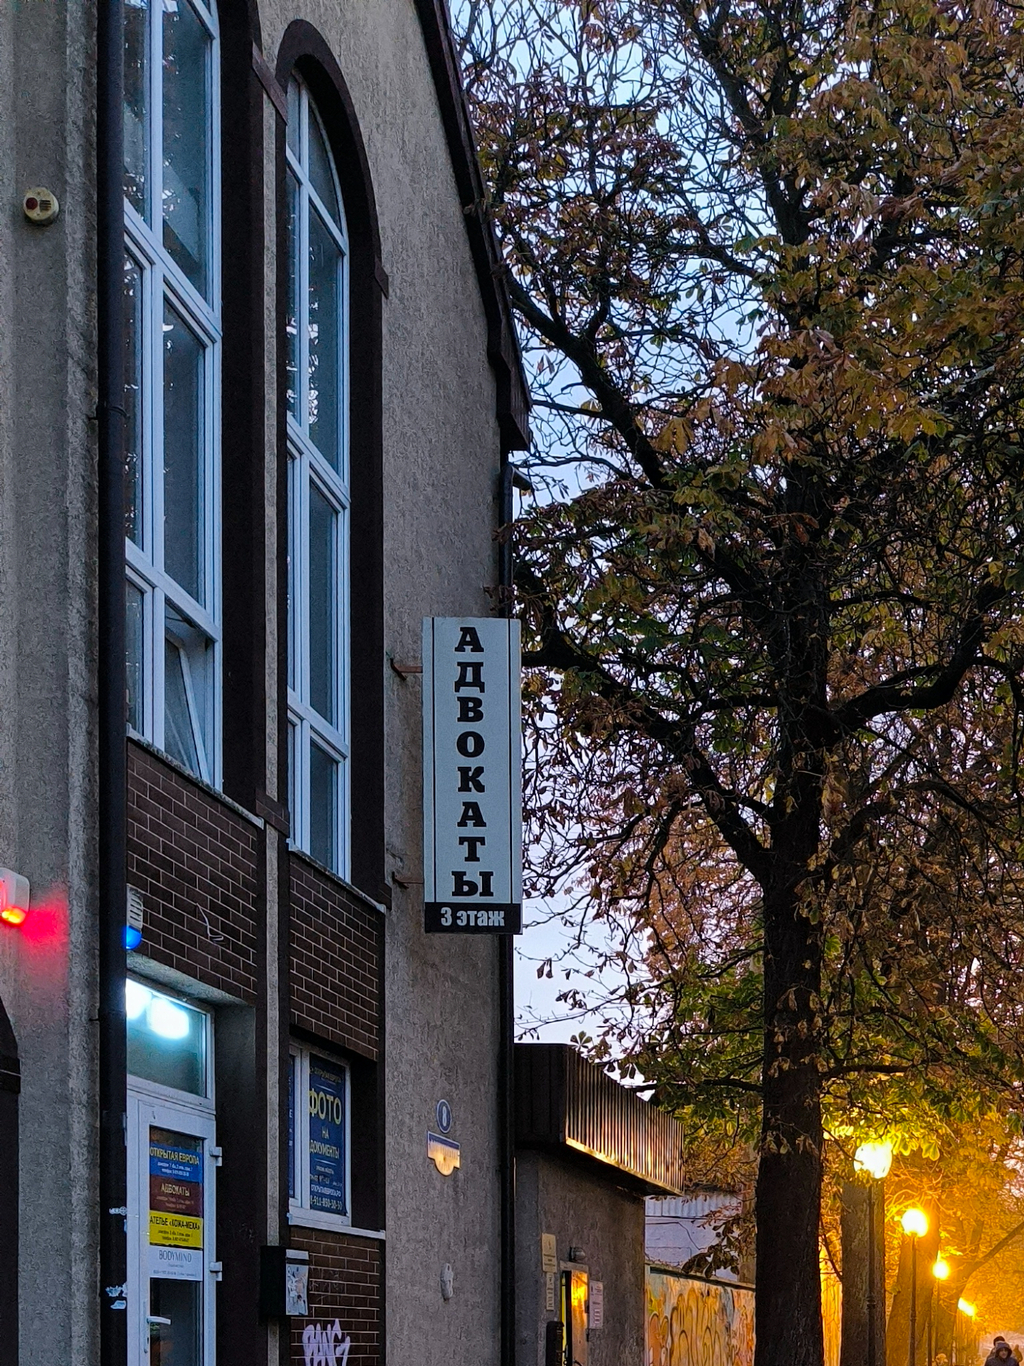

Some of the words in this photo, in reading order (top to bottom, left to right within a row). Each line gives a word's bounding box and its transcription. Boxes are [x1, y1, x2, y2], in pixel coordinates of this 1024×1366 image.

[451, 626, 494, 897] АДВОКАТЫ
[440, 906, 451, 927] 3
[456, 908, 505, 928] этаж
[309, 1088, 342, 1125] ФОТО
[442, 1106, 447, 1127] 8
[150, 1147, 178, 1160] ОТКРЫТАЯ
[179, 1153, 199, 1165] ЕВРОПА
[309, 1139, 339, 1159] ДОКУМЕНТЫ
[161, 1183, 190, 1196] АДВОКАТЫ
[150, 1215, 168, 1226] АТЕЛЬЕ
[159, 1250, 192, 1262] BODYMIND
